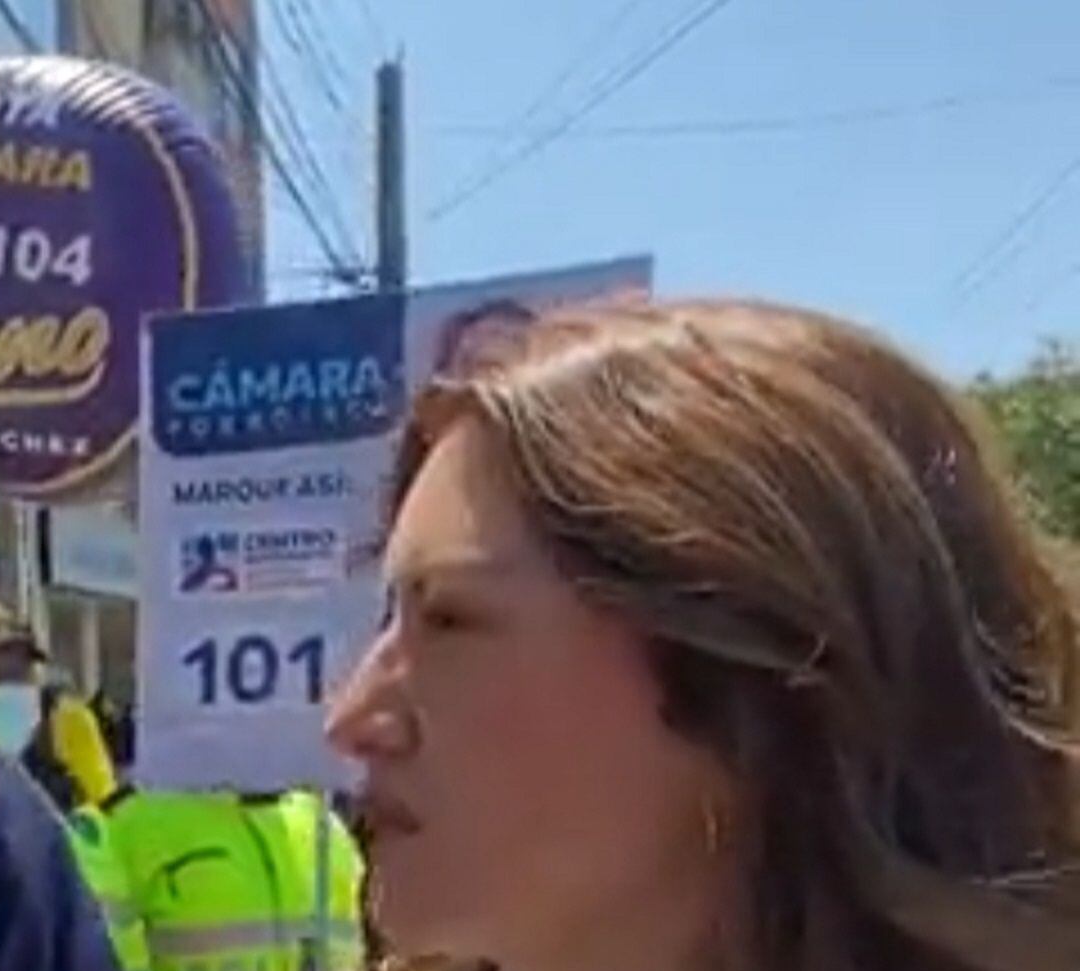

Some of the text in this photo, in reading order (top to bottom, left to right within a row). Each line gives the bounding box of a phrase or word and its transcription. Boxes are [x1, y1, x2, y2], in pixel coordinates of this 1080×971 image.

[168, 357, 387, 413] CÁMARA
[173, 477, 289, 506] MARQUE
[183, 633, 325, 705] 101
